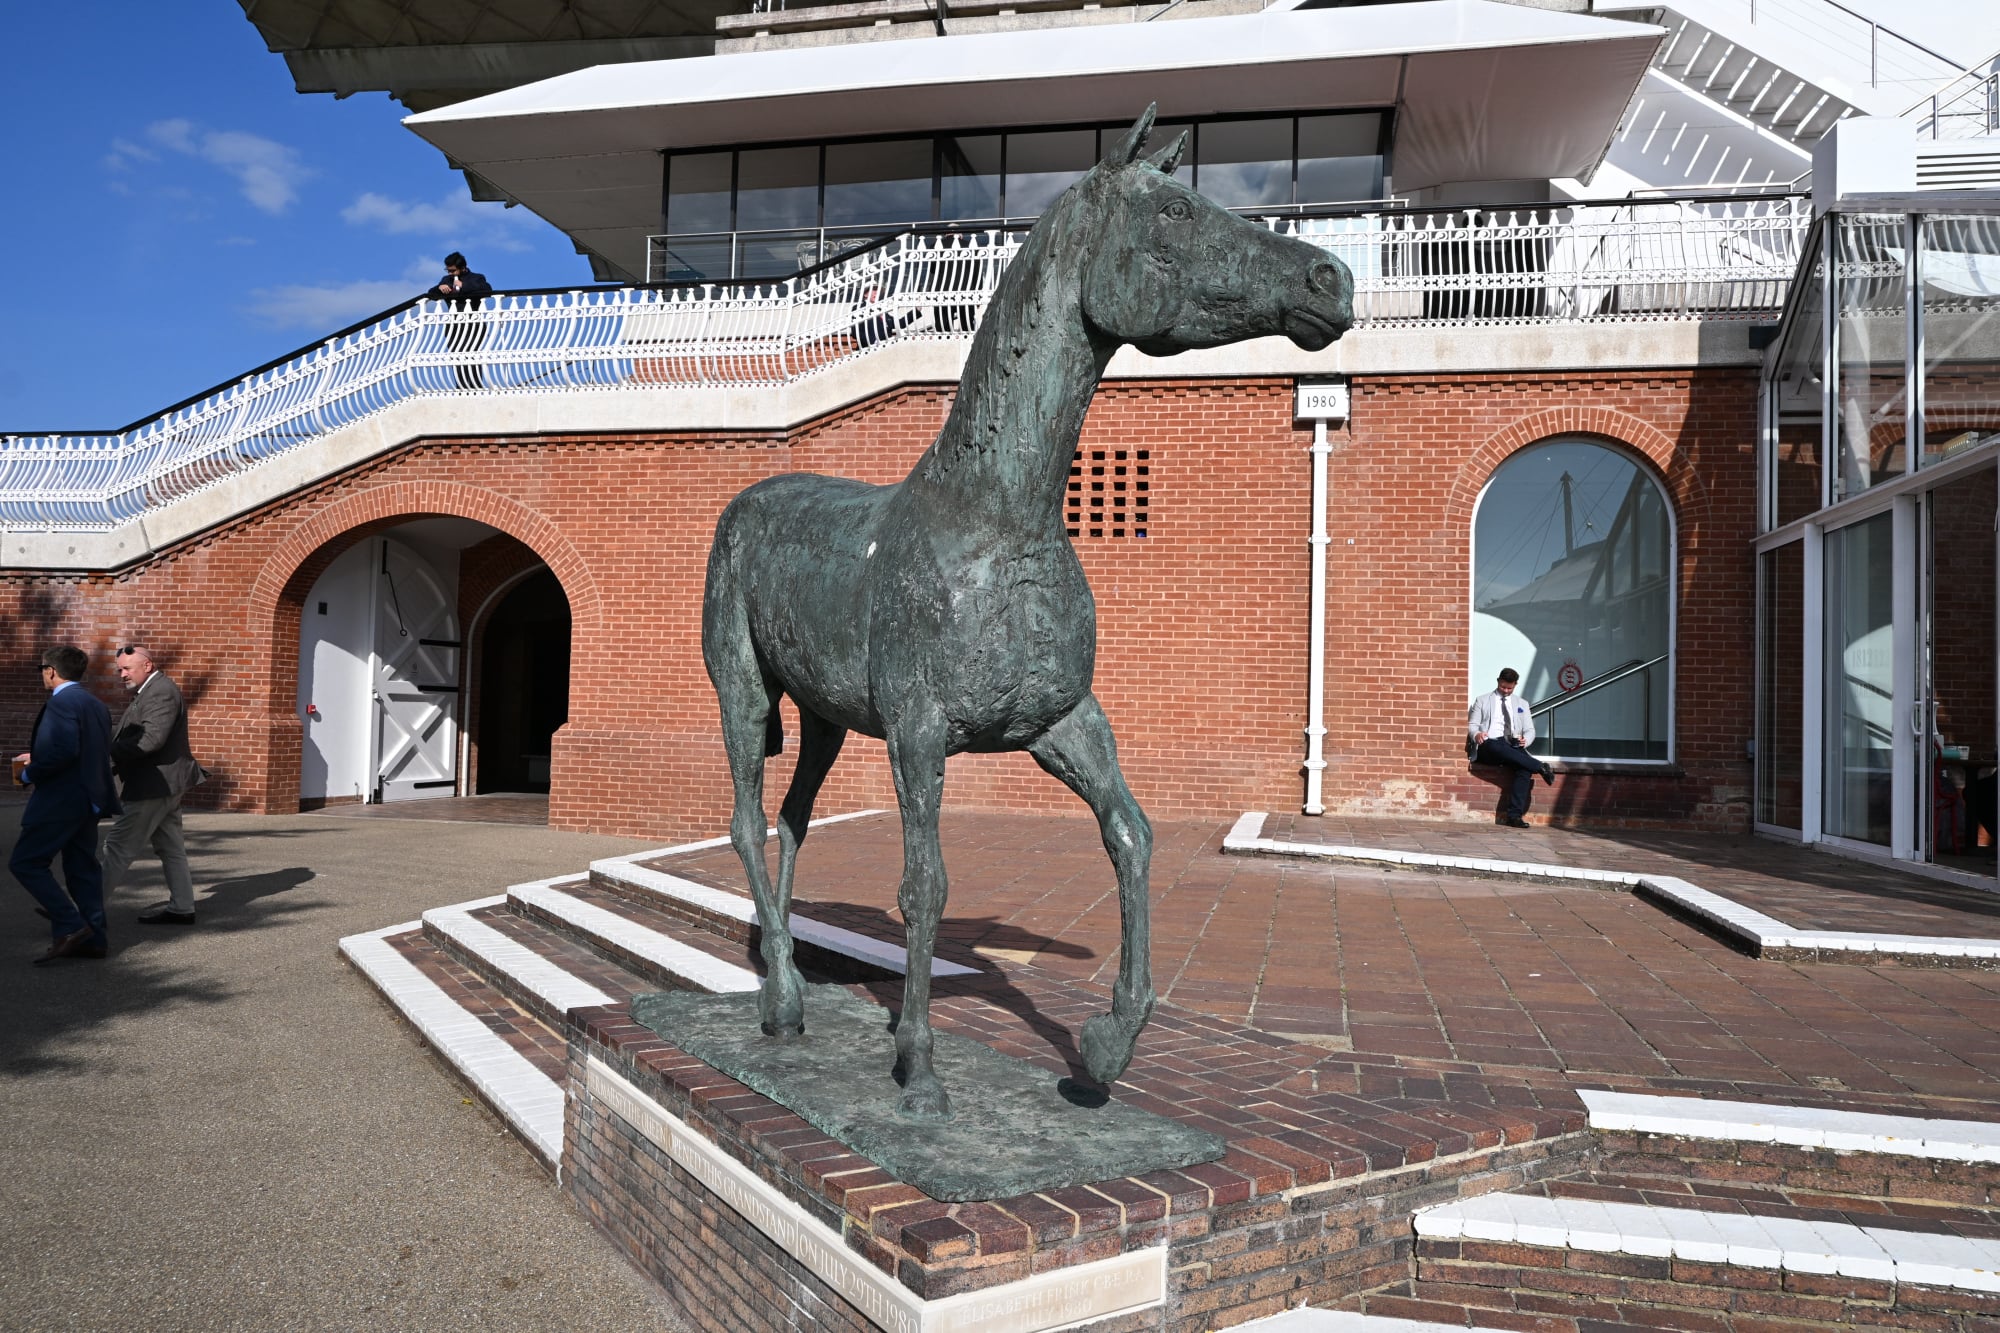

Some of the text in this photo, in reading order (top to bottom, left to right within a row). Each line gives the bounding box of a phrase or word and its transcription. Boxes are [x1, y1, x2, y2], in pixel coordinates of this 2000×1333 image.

[1307, 395, 1336, 408] 1980
[627, 1099, 641, 1127] THE
[641, 1110, 666, 1144] QUEEN
[668, 1130, 701, 1171] OPENED
[702, 1157, 722, 1190] THIS
[724, 1176, 795, 1246] GRANDSTAND
[800, 1234, 817, 1265] ON
[820, 1248, 848, 1289] JULY
[849, 1271, 882, 1319] 29TH
[961, 1292, 1043, 1325] ELISABETH
[1047, 1278, 1089, 1302] FRINK
